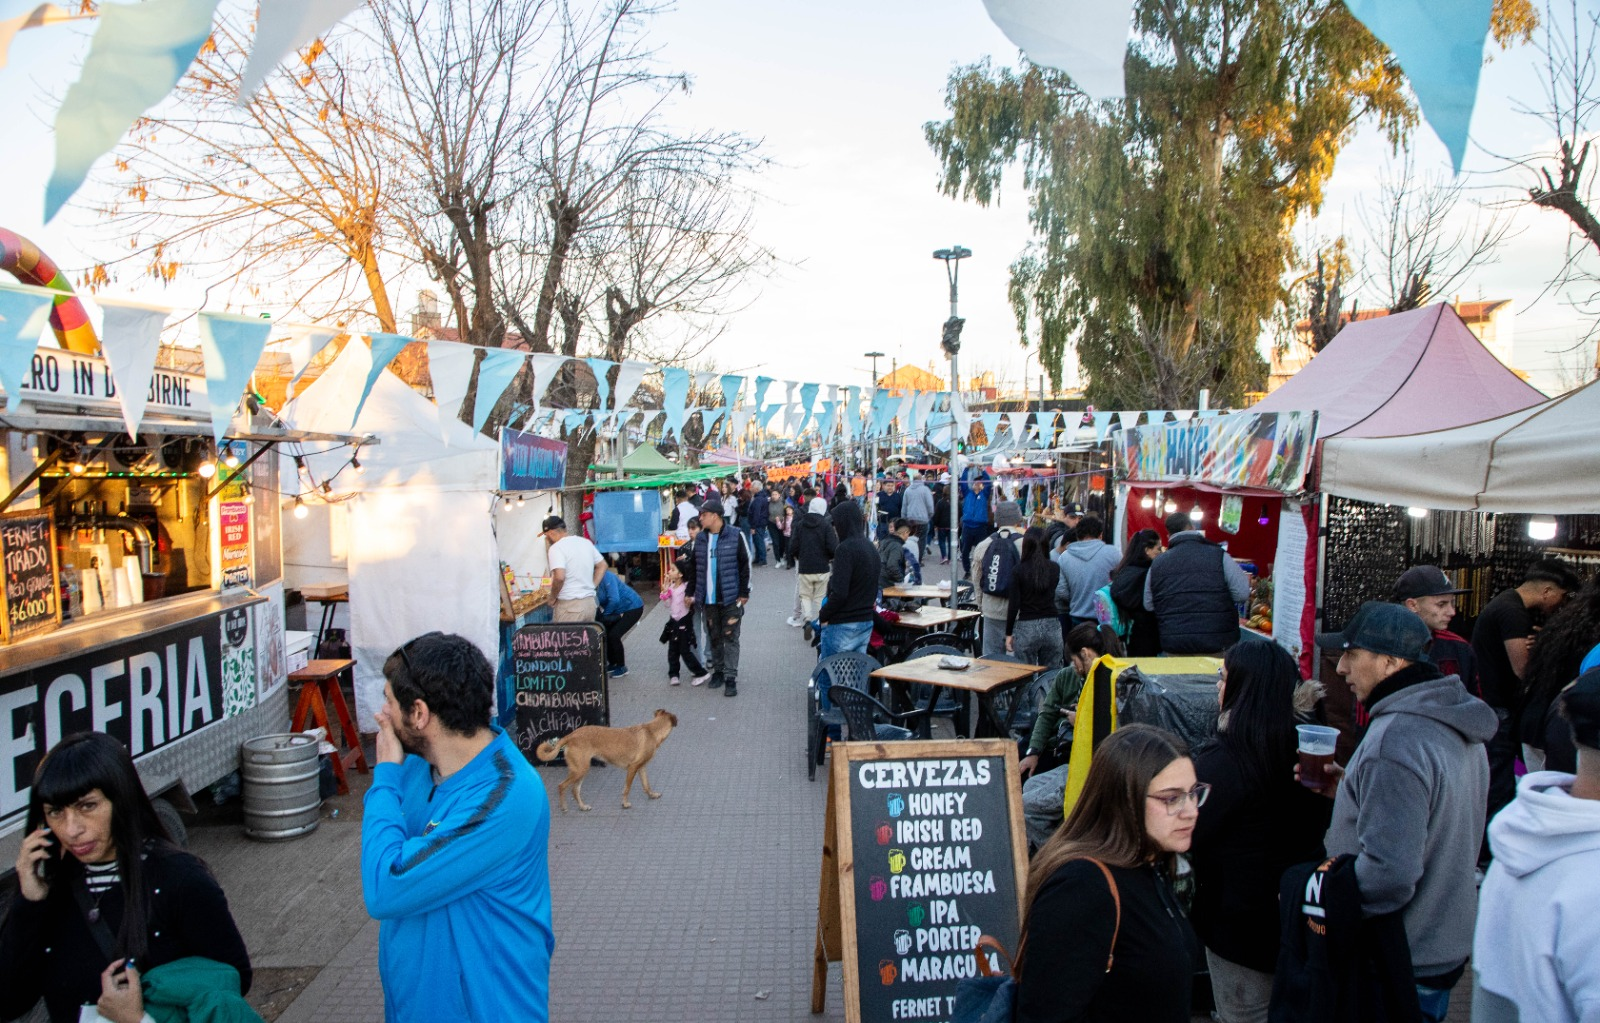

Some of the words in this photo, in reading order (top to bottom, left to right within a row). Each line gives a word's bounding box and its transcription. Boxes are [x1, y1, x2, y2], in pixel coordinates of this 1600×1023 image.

[73, 360, 94, 396] IN
[5, 545, 47, 574] TIRADO
[988, 554, 1000, 592] adidas
[516, 658, 573, 673] BONDIOLA
[858, 759, 991, 789] CERVEZAS
[908, 791, 967, 816] HONEY
[896, 819, 944, 844] IRISH
[950, 817, 982, 842] RED
[910, 845, 972, 870] CREAM
[889, 870, 996, 899] FRAMBUESA
[929, 899, 960, 924] IPA
[915, 925, 982, 953] PORTER
[901, 952, 1000, 983] MARACUA
[892, 996, 942, 1019] FERNET
